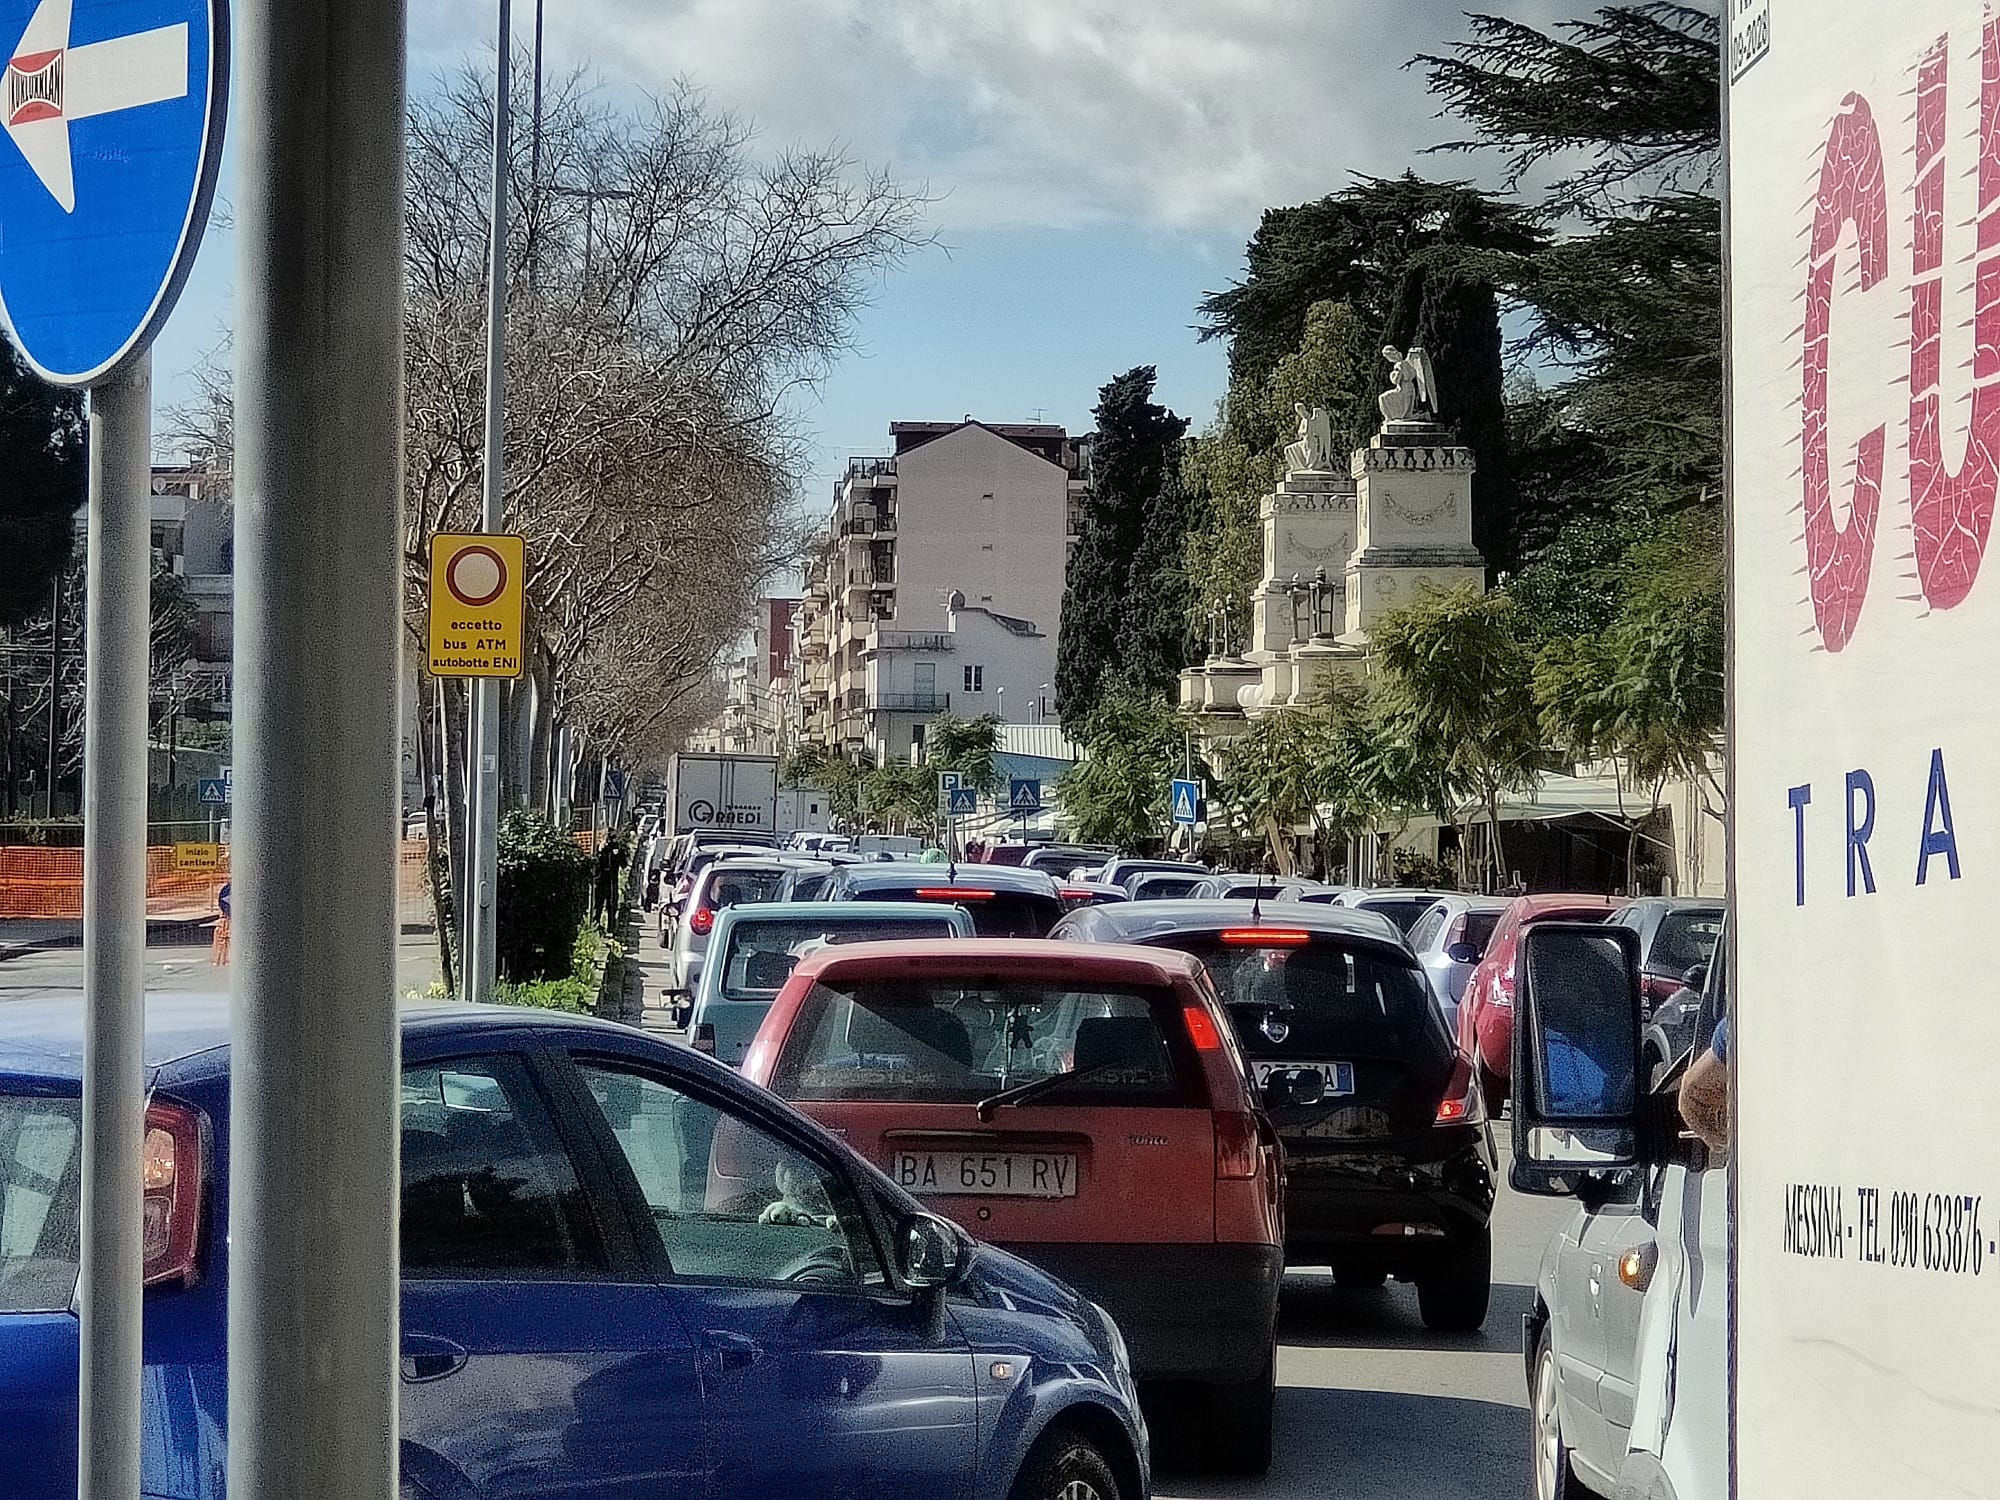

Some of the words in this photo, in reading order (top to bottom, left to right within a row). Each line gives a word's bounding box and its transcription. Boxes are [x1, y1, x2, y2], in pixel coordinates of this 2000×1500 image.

[451, 620, 502, 631] eccetto
[443, 638, 467, 650] bus
[476, 639, 507, 651] ATM
[432, 657, 490, 668] autobotte
[493, 657, 517, 669] ENI
[945, 776, 956, 788] P
[186, 847, 209, 856] inizio
[179, 858, 216, 867] cantiere
[901, 1156, 937, 1187] BA
[960, 1157, 1013, 1188] 651
[1033, 1156, 1069, 1194] RV
[1784, 1184, 1843, 1259] MESSINA
[1858, 1187, 1886, 1264] TEL.
[1891, 1191, 1918, 1268] 090
[1923, 1193, 1982, 1275] 633876
